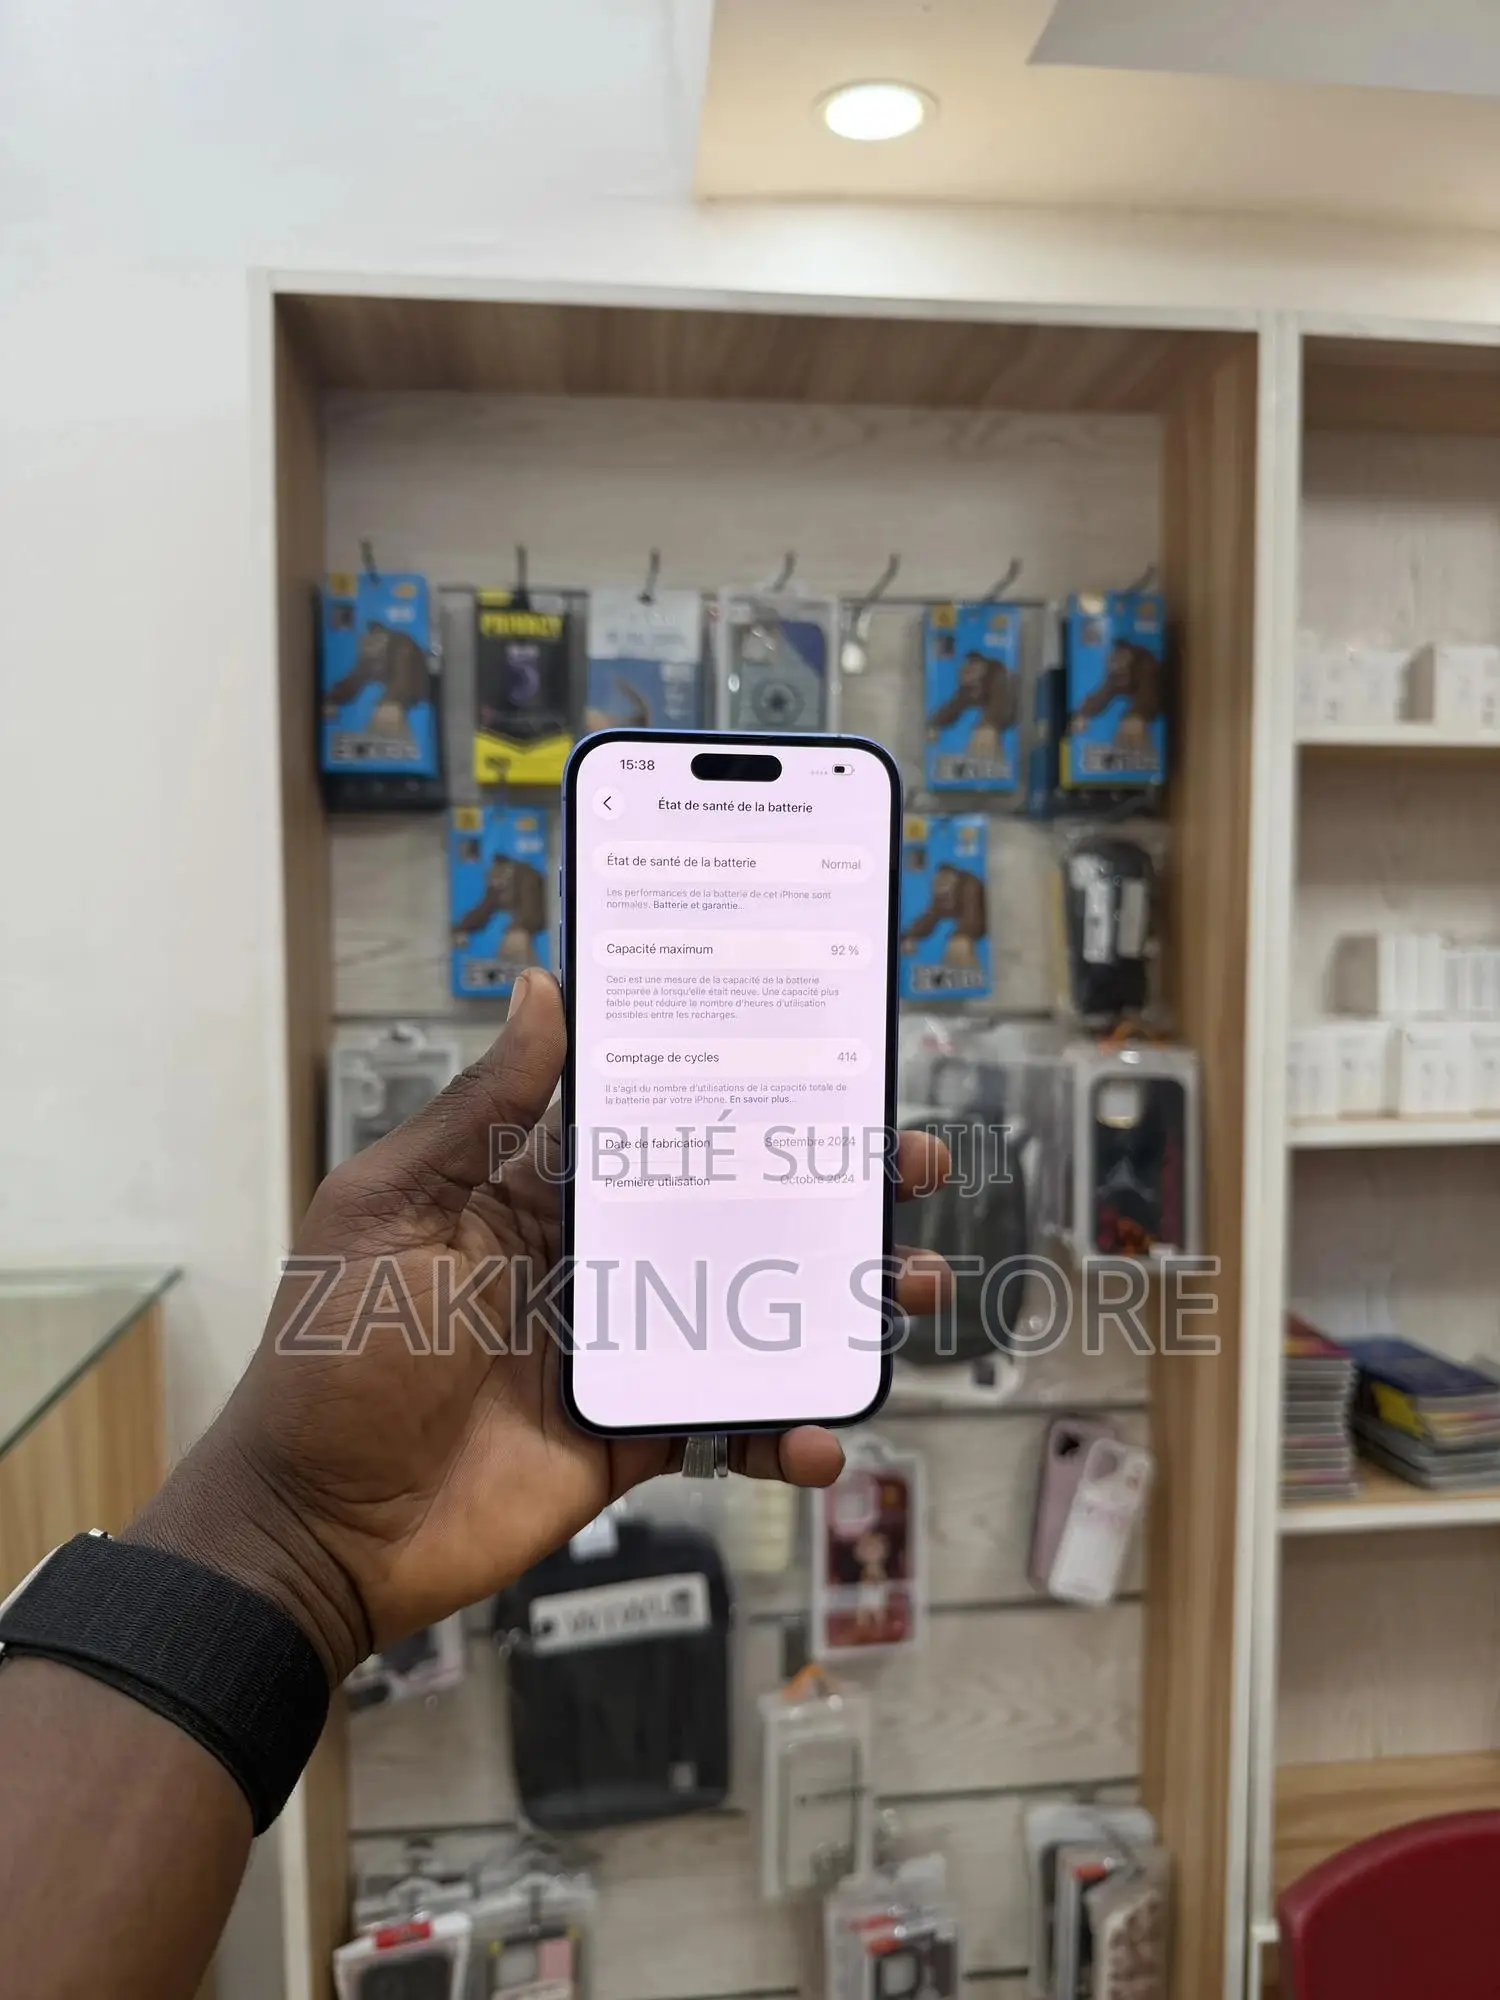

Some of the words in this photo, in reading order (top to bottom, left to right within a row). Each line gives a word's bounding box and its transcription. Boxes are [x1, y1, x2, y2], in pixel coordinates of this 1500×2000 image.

[620, 759, 655, 771] 15:38
[658, 797, 681, 810] État
[684, 800, 699, 811] de
[702, 799, 735, 812] santé
[737, 801, 752, 812] de
[754, 801, 766, 813] la
[768, 802, 813, 814] batterie
[607, 853, 630, 866] État
[632, 855, 647, 867] de
[650, 854, 680, 867] santé
[684, 856, 698, 867] de
[701, 856, 711, 868] la
[714, 857, 757, 869] batterie
[821, 859, 861, 870] Normal
[606, 888, 622, 897] Les
[624, 888, 687, 898] performances
[689, 889, 701, 898] de
[703, 889, 711, 898] la
[713, 889, 748, 898] batterie
[750, 890, 761, 899] de
[763, 890, 777, 899] cet
[779, 890, 809, 899] iPhone
[812, 891, 832, 899] sont
[653, 900, 688, 909] Batterie
[690, 901, 699, 909] et
[606, 943, 656, 956] Capacité
[659, 943, 713, 954] maximum
[830, 945, 846, 956] 92
[606, 975, 626, 984] Ceci
[628, 976, 642, 984] est
[644, 976, 661, 984] une
[664, 976, 697, 984] mesure
[699, 975, 711, 984] de
[712, 975, 721, 984] la
[723, 976, 760, 986] capacité
[762, 976, 774, 984] de
[776, 976, 784, 984] la
[786, 976, 820, 984] batterie
[606, 987, 651, 997] comparée
[708, 987, 728, 996] était
[762, 987, 780, 996] Une
[781, 987, 819, 997] capacité
[821, 987, 839, 997] plus
[606, 999, 631, 1007] faible
[633, 1000, 653, 1009] peut
[655, 999, 687, 1007] réduire
[689, 999, 697, 1007] le
[700, 999, 734, 1007] nombre
[606, 1011, 649, 1020] possibles
[650, 1011, 674, 1019] entre
[676, 1011, 689, 1019] les
[606, 1052, 664, 1065] Comptage
[667, 1052, 682, 1063] de
[684, 1052, 720, 1065] cycles
[837, 1052, 857, 1063] 414
[605, 1084, 611, 1093] Il
[639, 1084, 651, 1092] du
[653, 1084, 687, 1093] nombre
[747, 1083, 758, 1092] de
[760, 1083, 768, 1092] la
[770, 1083, 807, 1093] capacité
[809, 1083, 833, 1092] totale
[836, 1083, 847, 1091] de
[605, 1096, 613, 1104] la
[615, 1096, 650, 1104] batterie
[652, 1097, 667, 1105] par
[670, 1096, 692, 1104] votre
[730, 1095, 741, 1103] En
[743, 1095, 768, 1104] savoir
[605, 1139, 631, 1149] Date
[635, 1139, 648, 1149] de
[652, 1138, 710, 1149] fabrication
[765, 1136, 824, 1149] Septembre
[827, 1136, 856, 1147] 2024
[605, 1177, 655, 1188] Première
[658, 1176, 710, 1187] utilisation
[781, 1174, 824, 1186] Octobre
[827, 1174, 855, 1185] 2024
